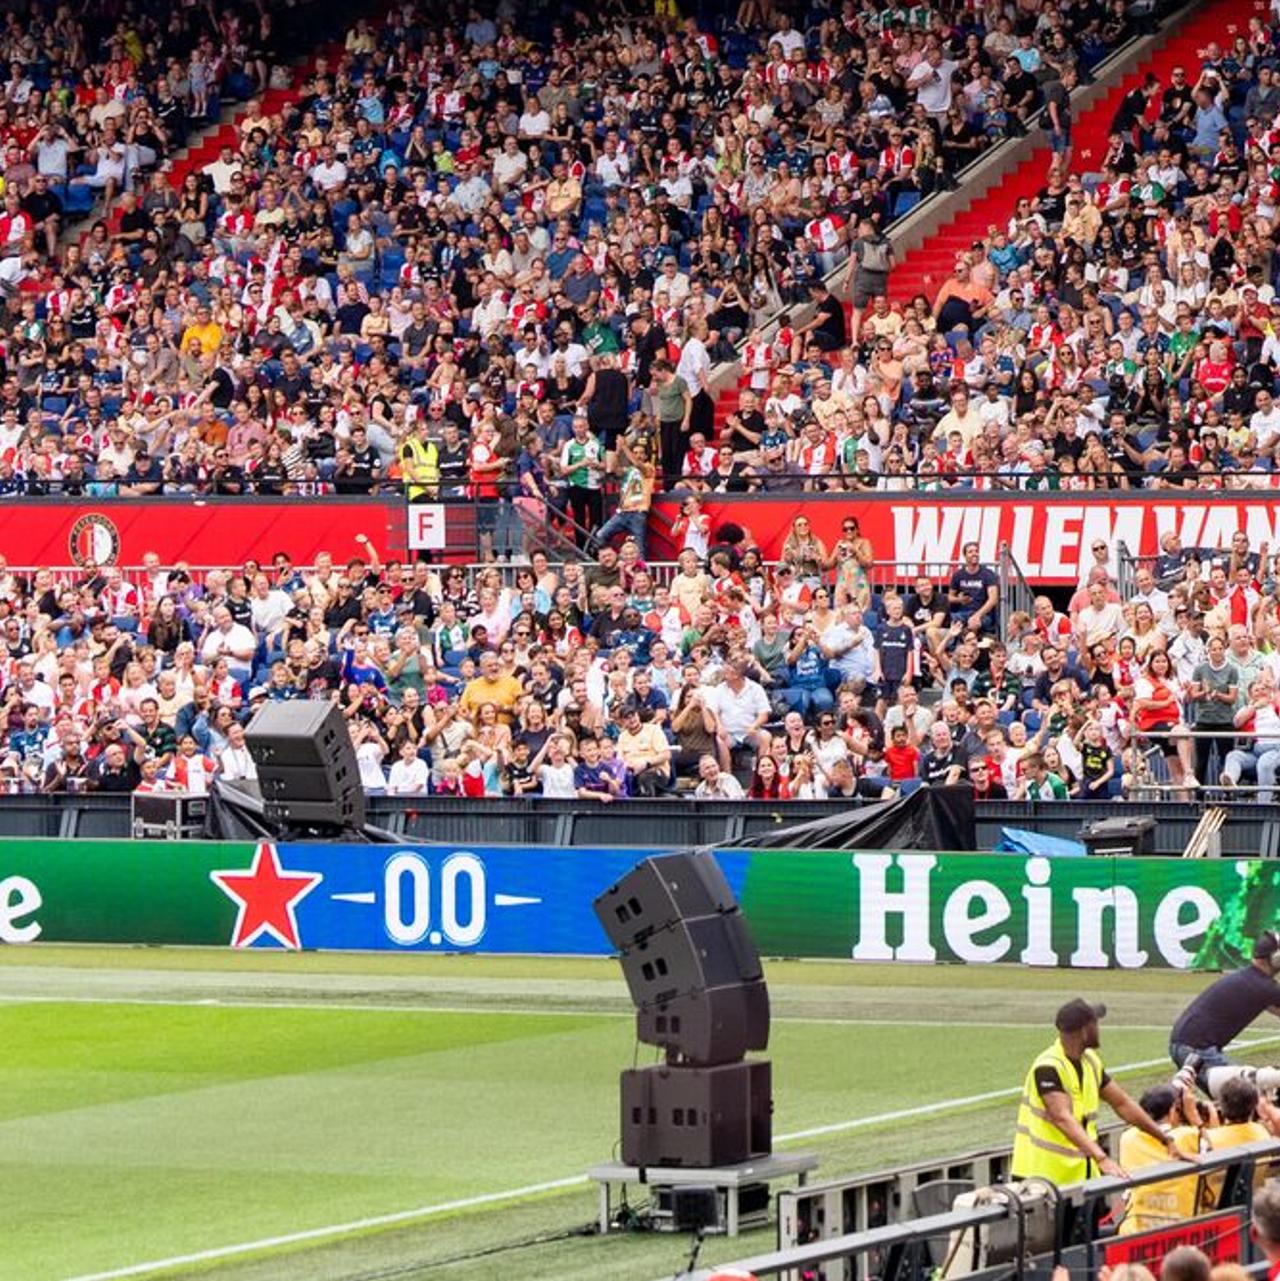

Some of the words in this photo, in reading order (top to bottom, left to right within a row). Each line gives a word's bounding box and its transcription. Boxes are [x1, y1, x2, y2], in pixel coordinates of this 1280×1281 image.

[417, 512, 435, 542] F
[891, 505, 1146, 579] WILLEM
[383, 851, 486, 946] 0.0
